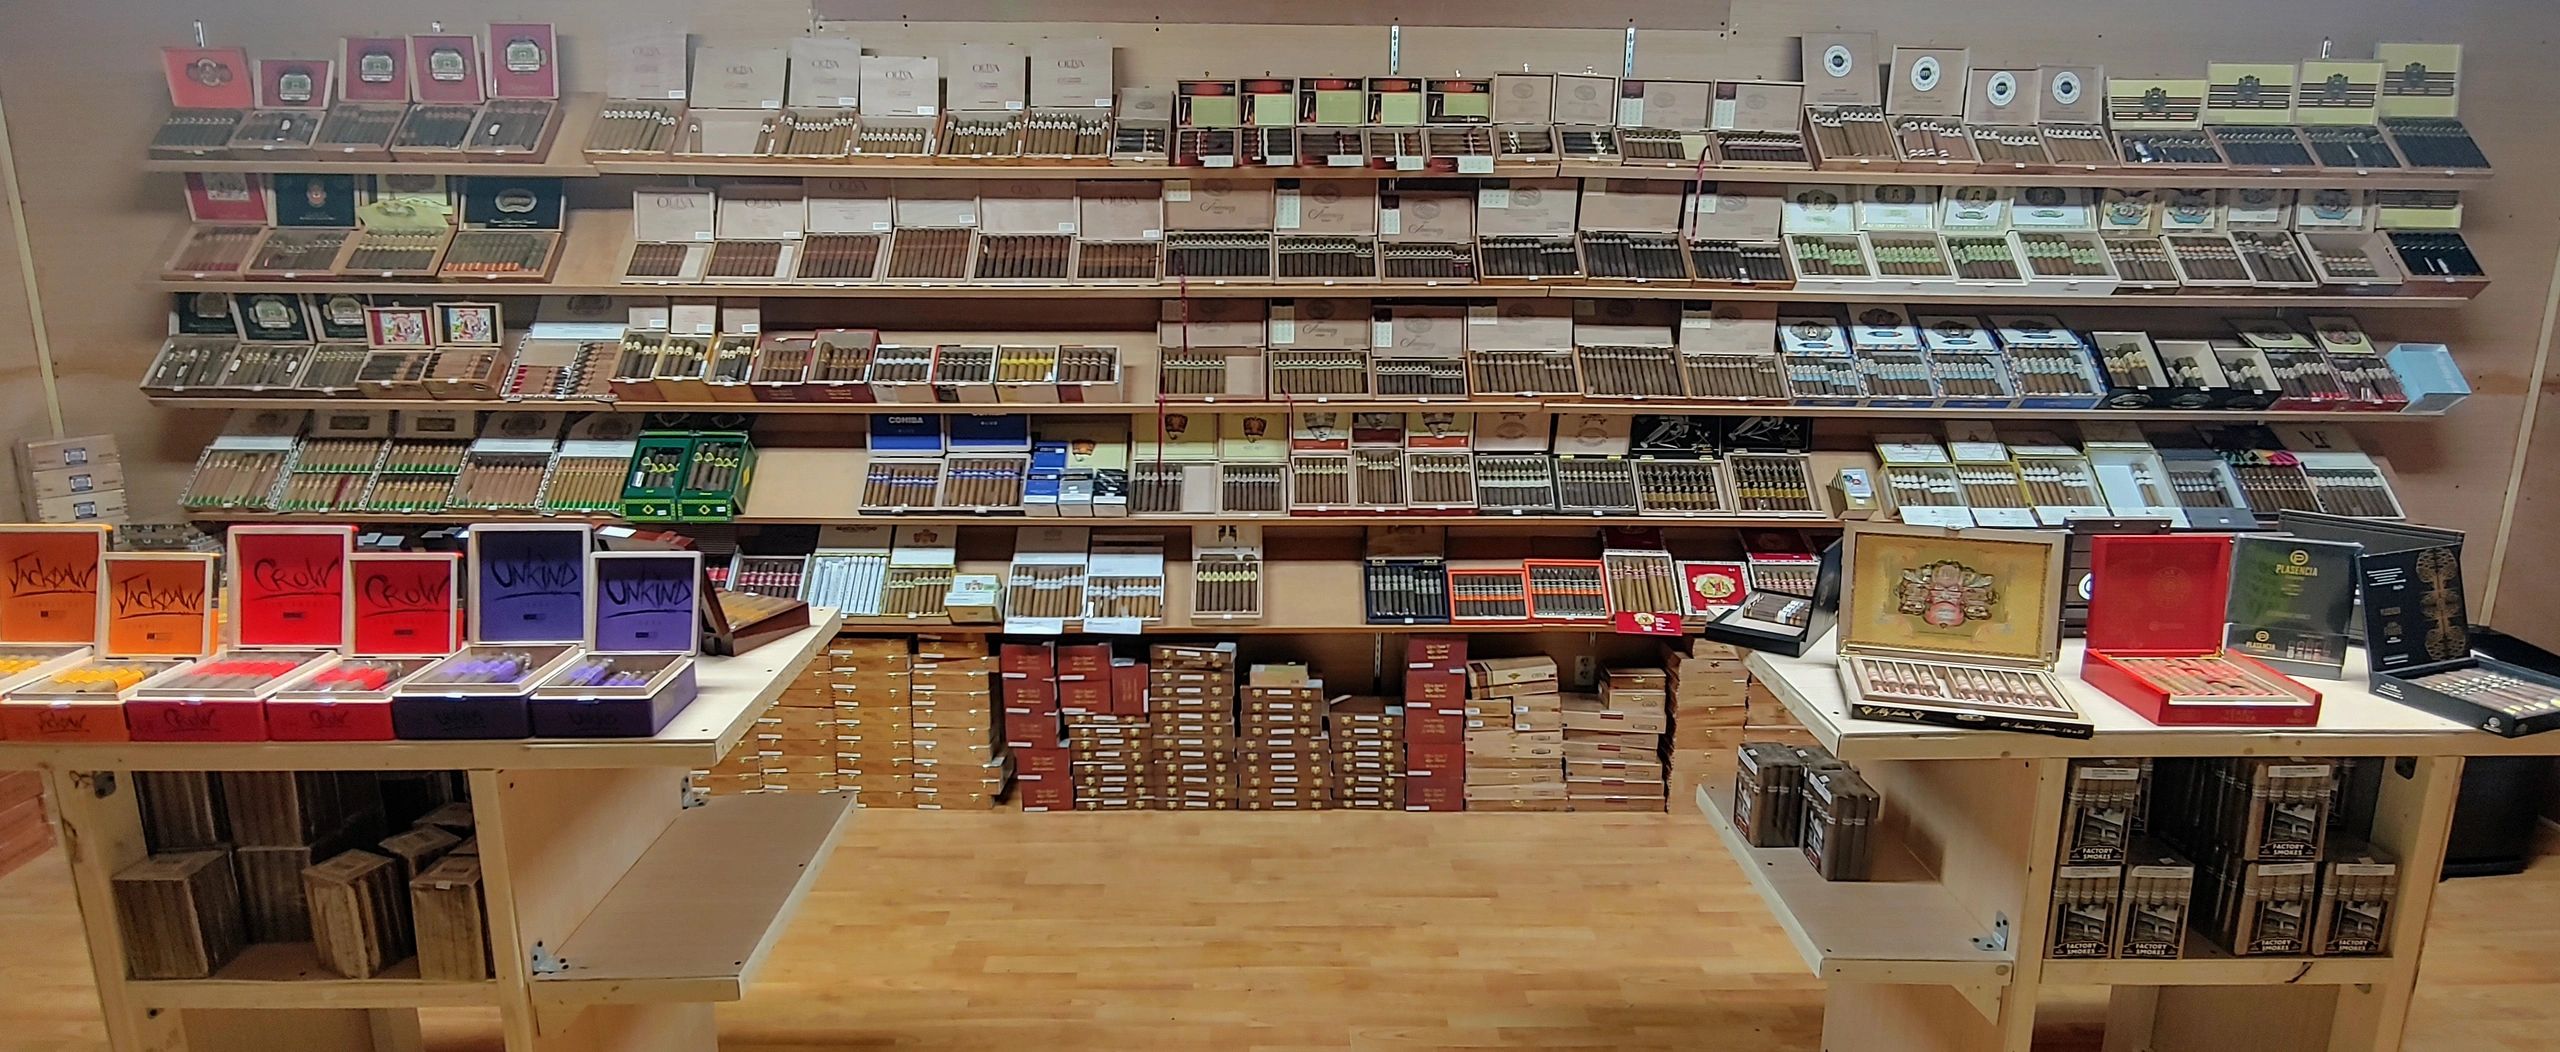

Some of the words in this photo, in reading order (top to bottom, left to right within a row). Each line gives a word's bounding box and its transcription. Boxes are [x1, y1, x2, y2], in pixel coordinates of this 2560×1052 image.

[888, 416, 924, 424] COHIBA
[253, 556, 340, 592] CROW
[2275, 564, 2318, 577] PLASENCIA
[364, 573, 450, 609] CROW
